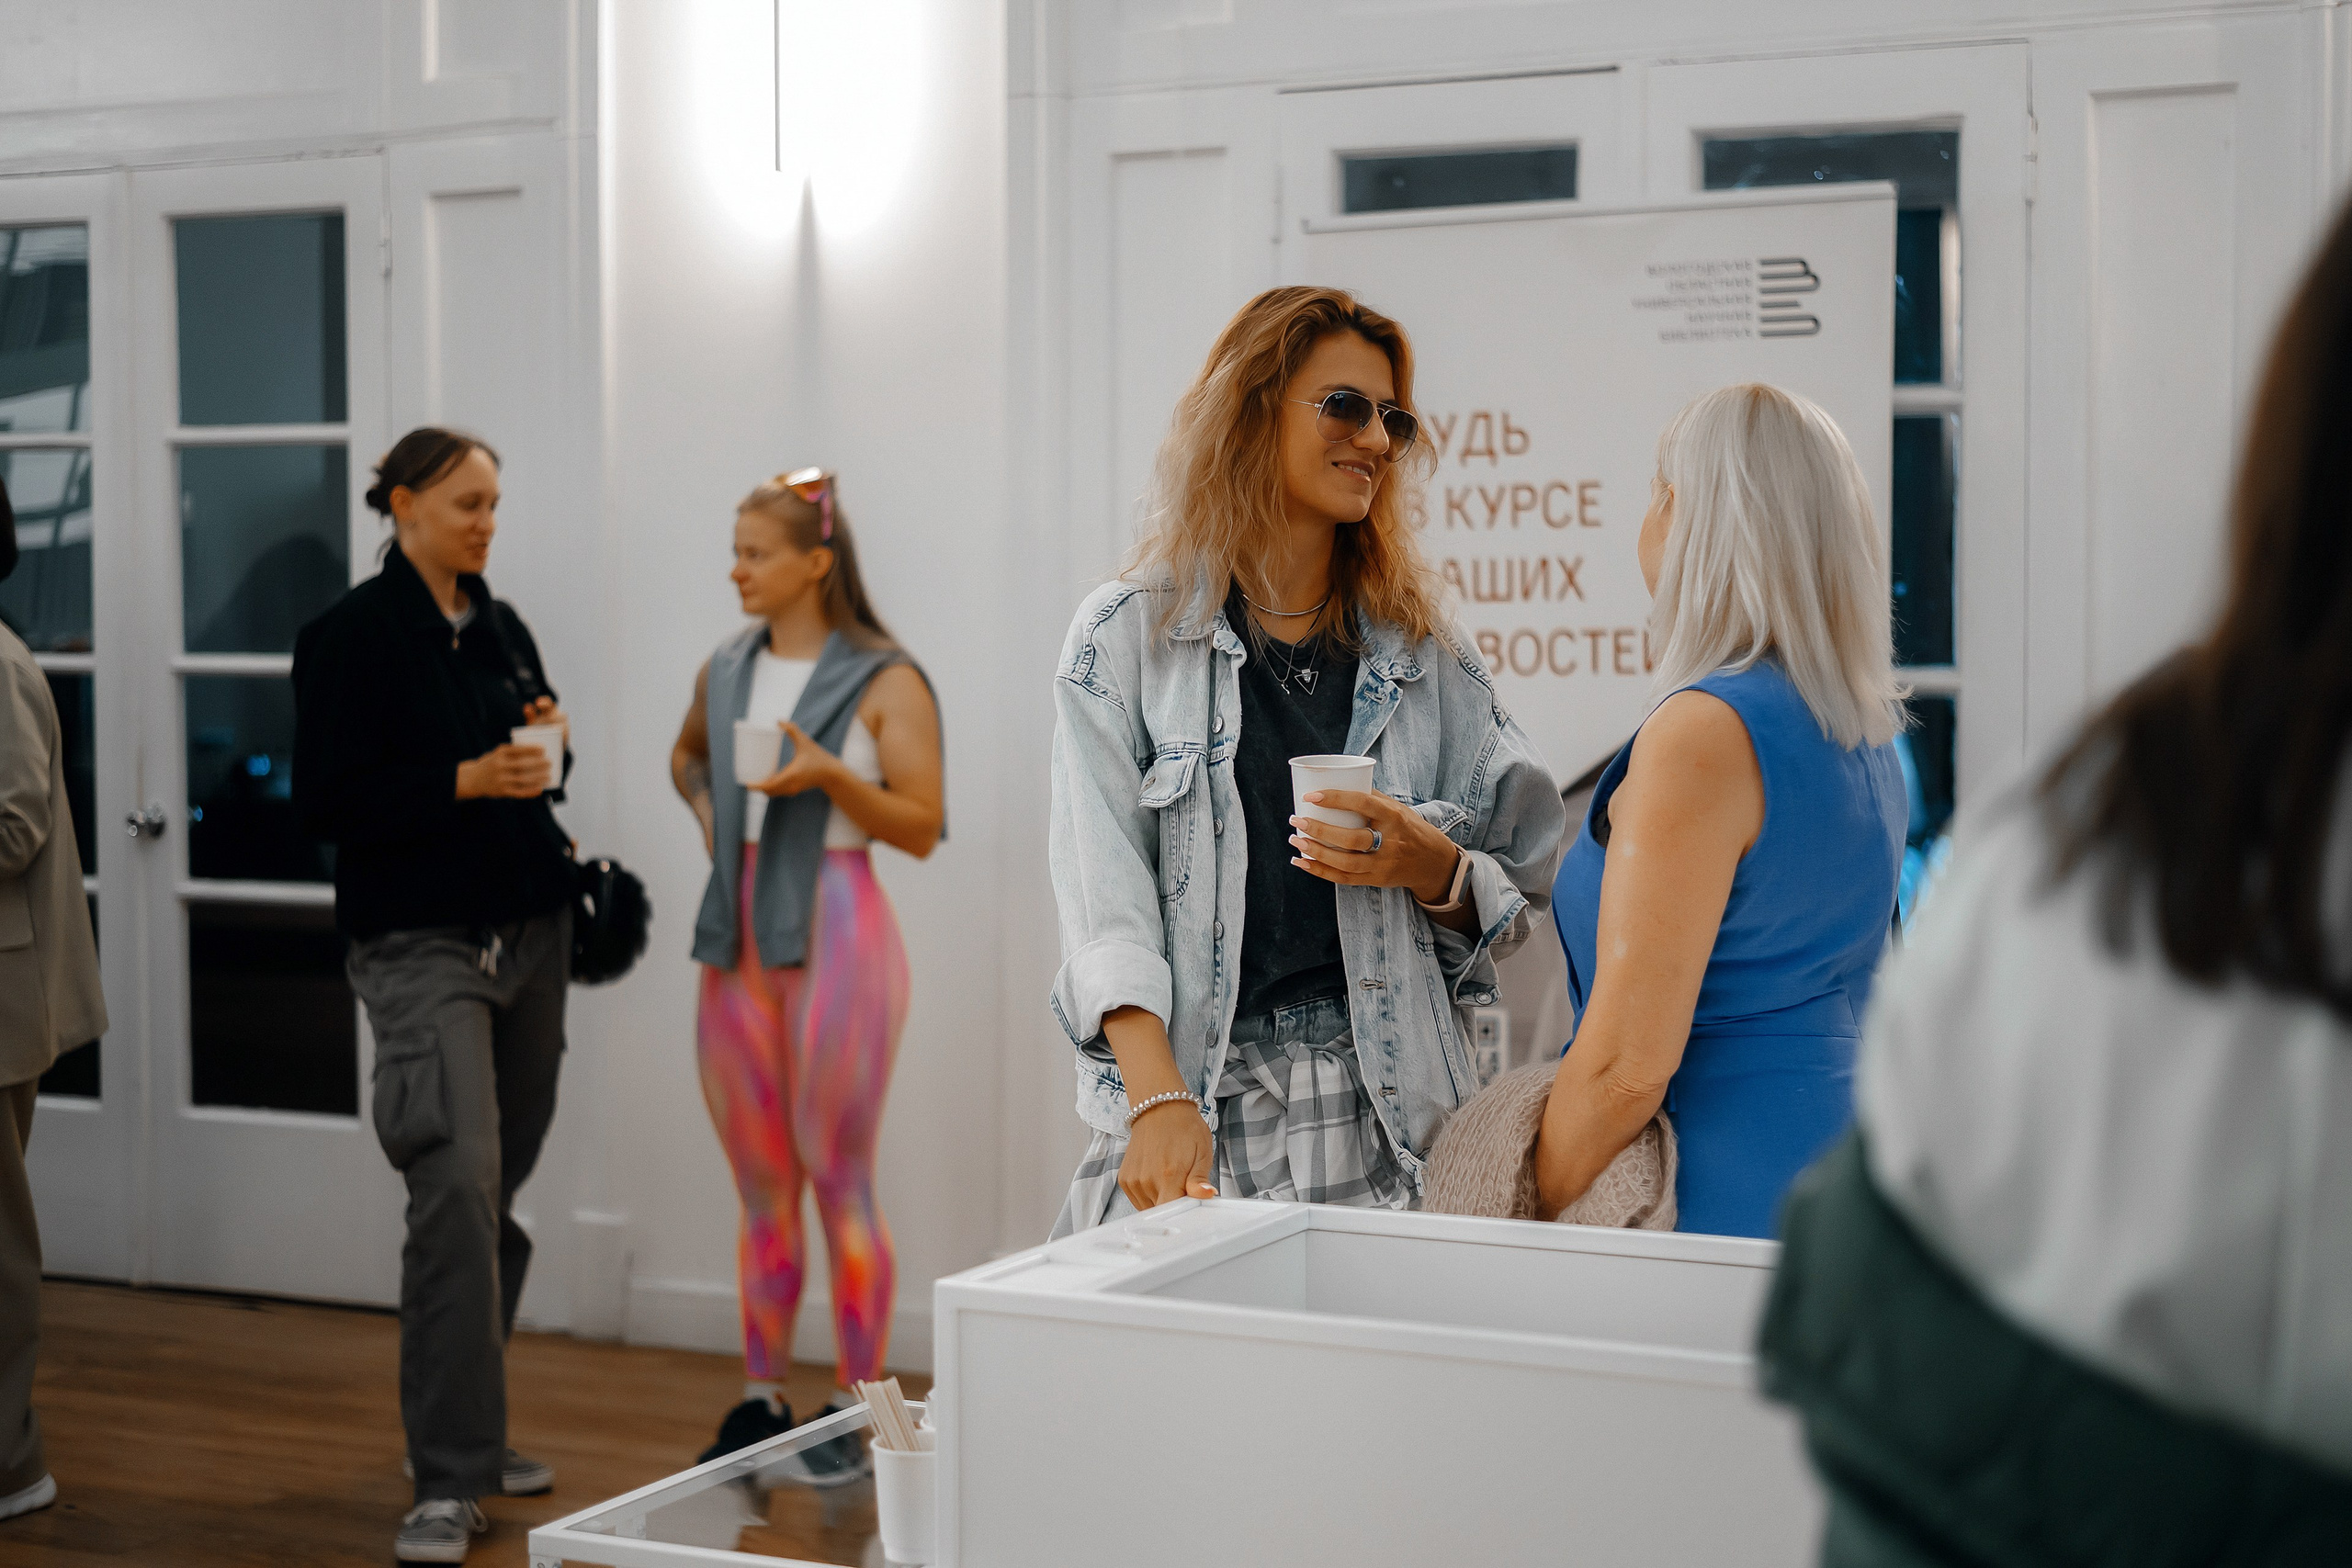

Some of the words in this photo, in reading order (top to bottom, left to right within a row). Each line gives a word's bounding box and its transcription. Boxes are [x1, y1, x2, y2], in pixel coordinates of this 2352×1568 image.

[1428, 411, 1531, 466] УДЬ
[1444, 479, 1603, 530] КУРСЕ
[1440, 557, 1585, 603] АШИХ
[1476, 617, 1655, 678] ВОСТЕ
